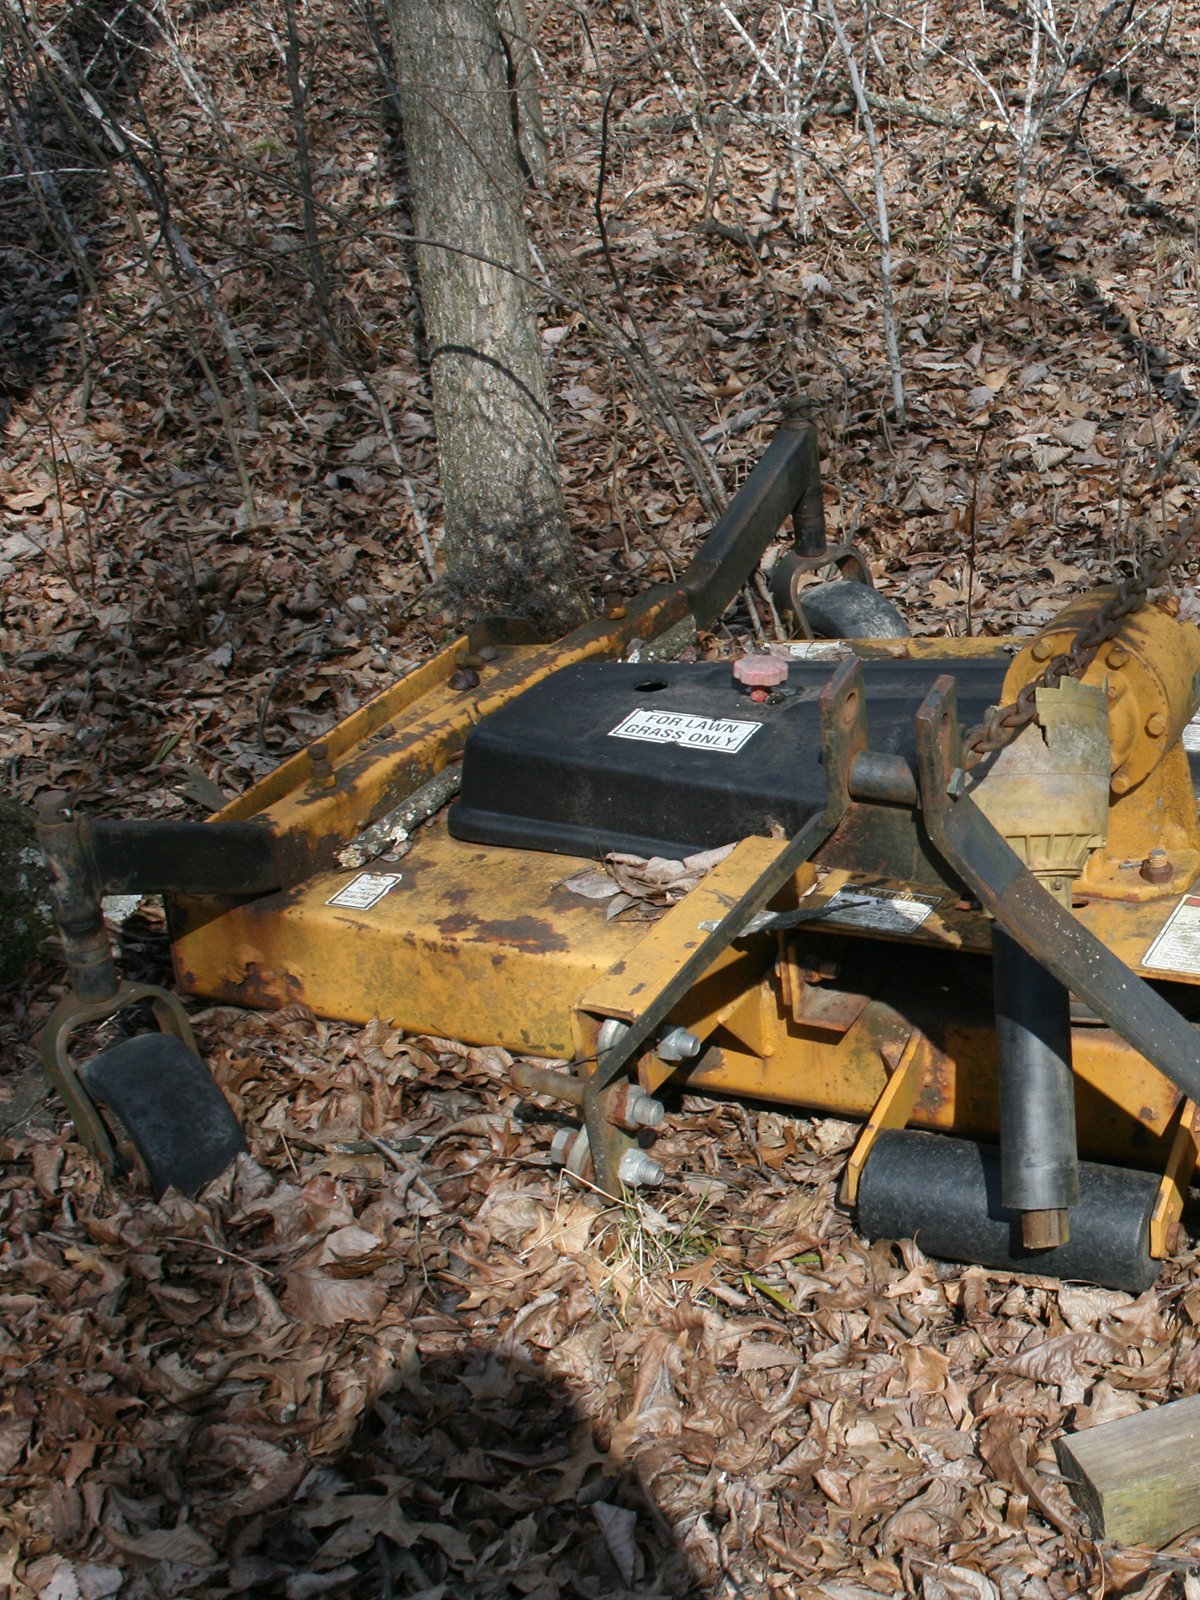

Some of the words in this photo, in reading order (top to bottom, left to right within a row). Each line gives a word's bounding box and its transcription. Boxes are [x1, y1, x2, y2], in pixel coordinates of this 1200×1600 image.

[645, 714, 682, 726] FOR
[685, 718, 739, 734] LAWN
[624, 724, 685, 740] GRASS
[688, 733, 738, 747] ONLY
